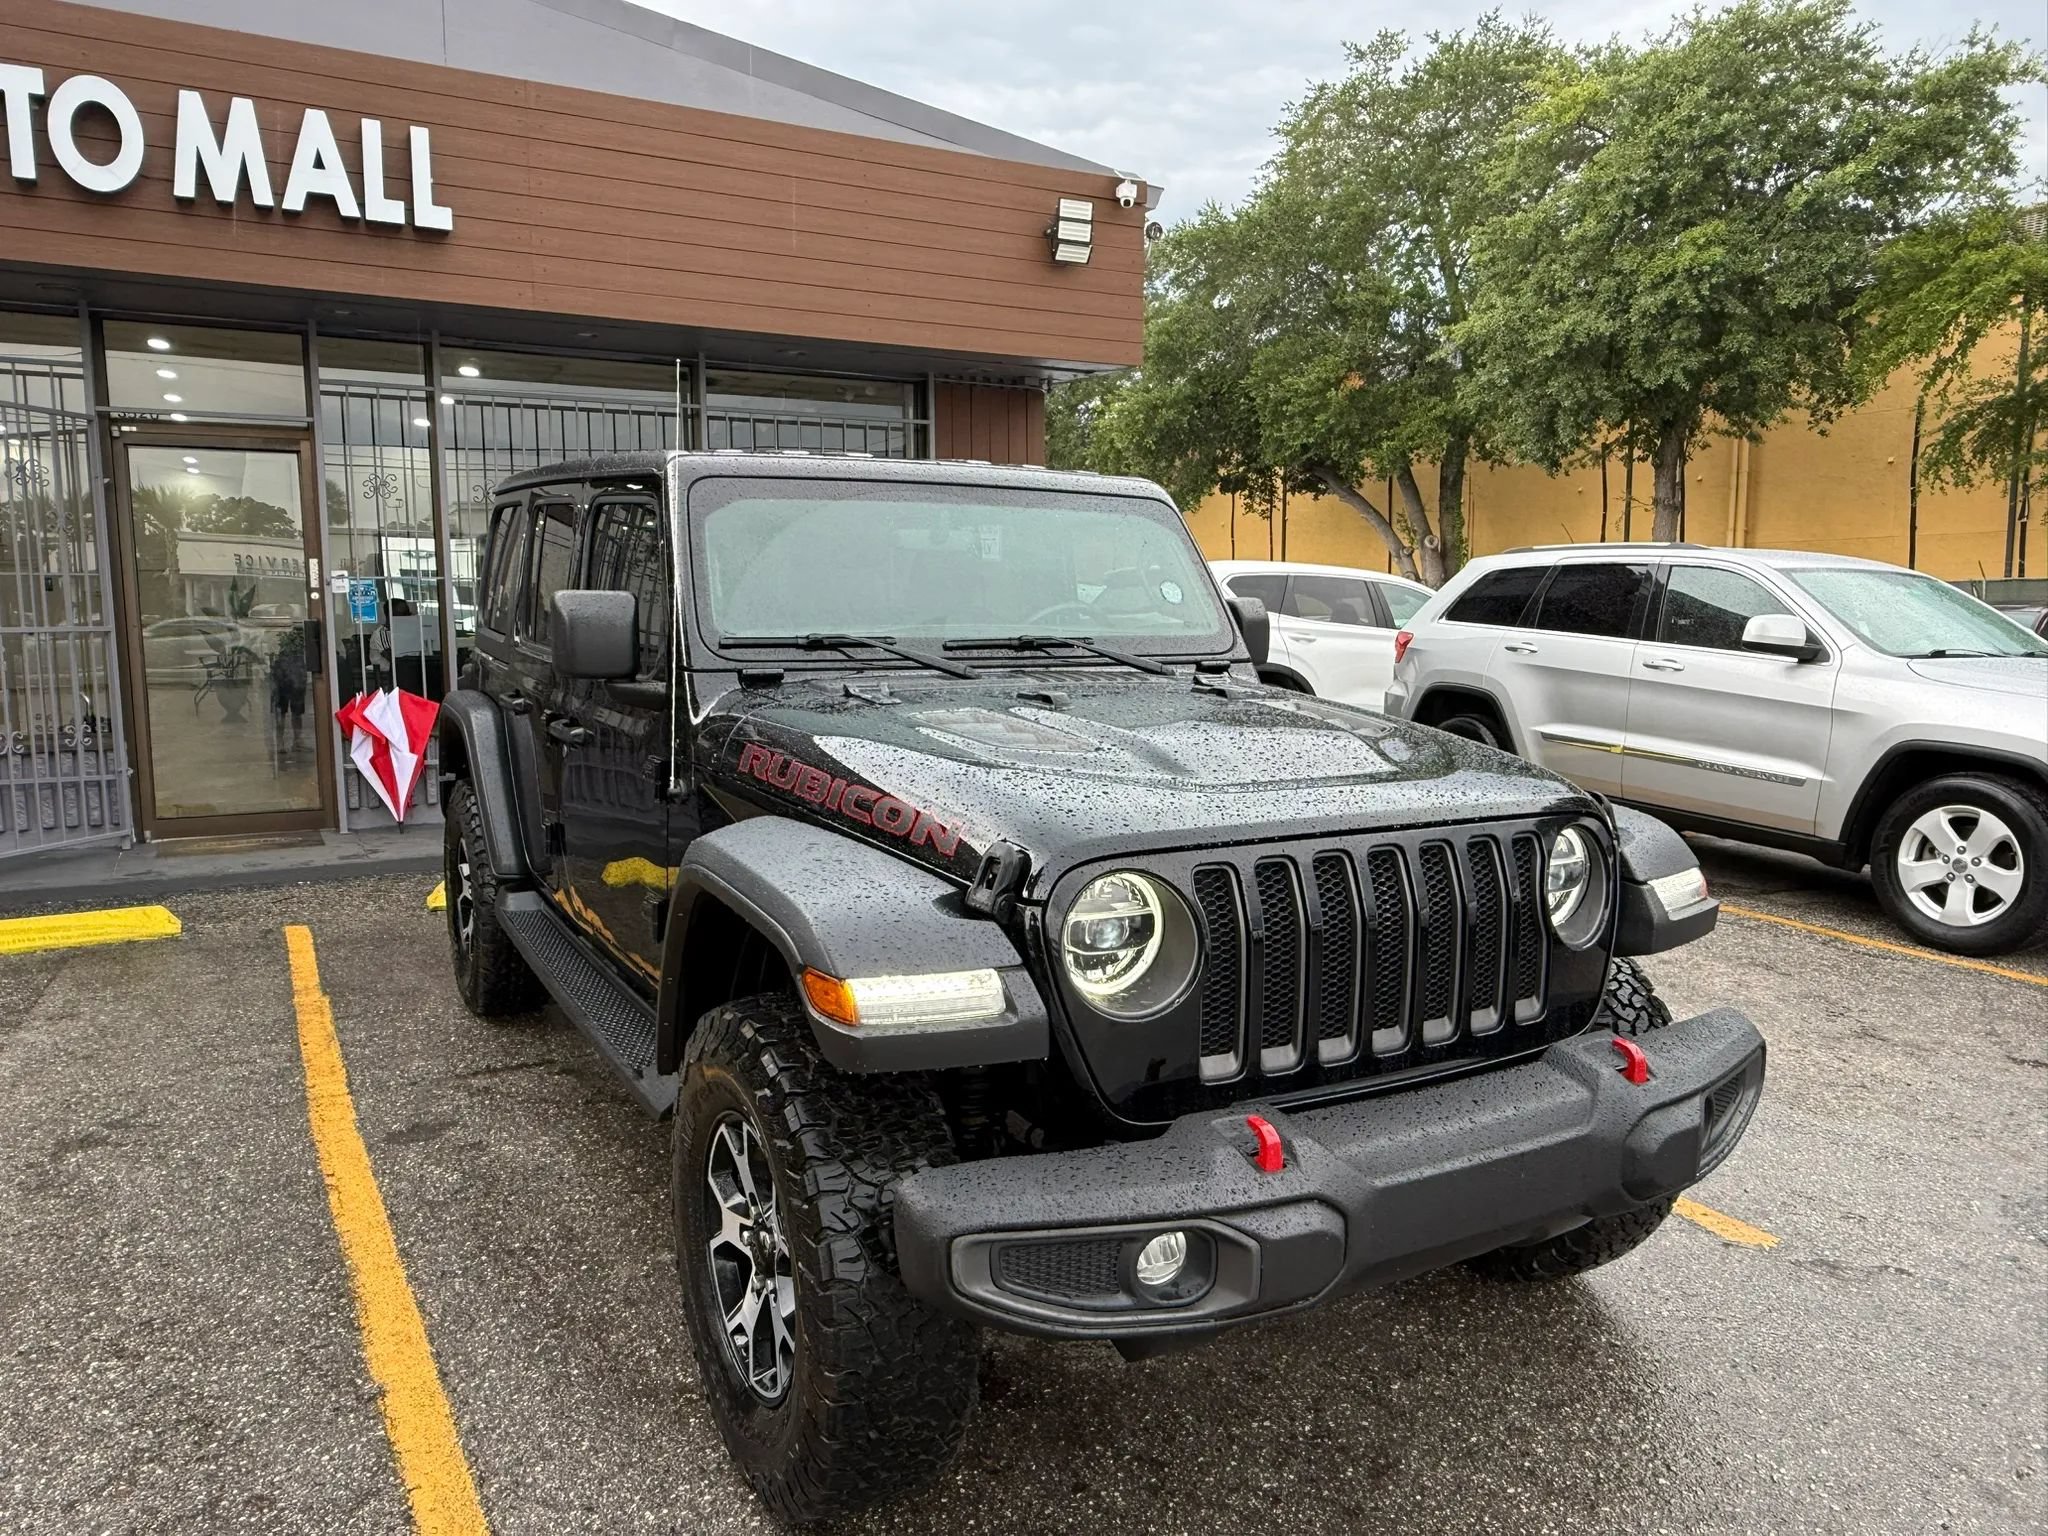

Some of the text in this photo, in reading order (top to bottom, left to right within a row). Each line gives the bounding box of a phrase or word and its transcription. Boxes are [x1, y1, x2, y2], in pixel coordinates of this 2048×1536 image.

[0, 63, 454, 232] TO MALL
[737, 742, 966, 857] RUBICON
